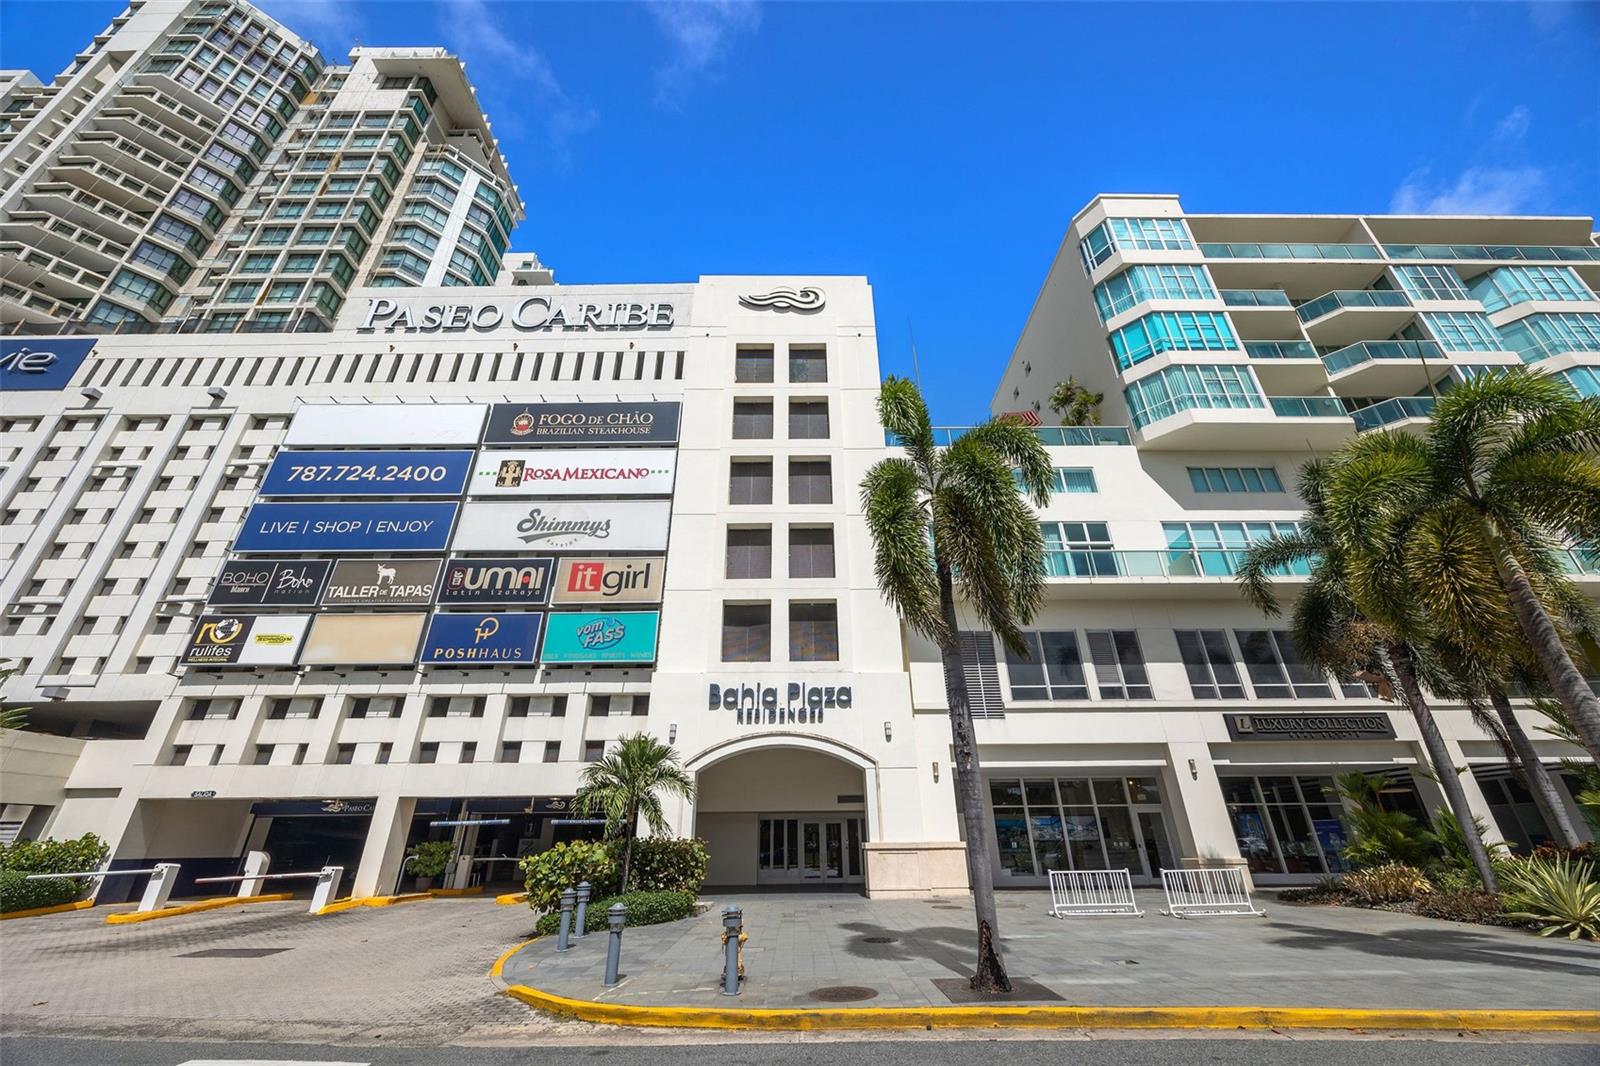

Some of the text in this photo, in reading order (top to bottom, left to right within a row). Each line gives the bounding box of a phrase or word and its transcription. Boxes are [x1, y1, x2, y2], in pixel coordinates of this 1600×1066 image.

[356, 296, 675, 333] PASEO CARIBE
[539, 411, 654, 425] FOGO DE CHÃO
[536, 426, 651, 436] BRAZILIAN STEAKHOUSE
[286, 466, 447, 482] 787.724.2400
[259, 520, 434, 534] LIVE SHOP ENJOY
[516, 508, 612, 539] Shimmys
[220, 572, 270, 584] BOHO
[276, 566, 314, 590] Boho
[328, 585, 379, 598] TALLER
[389, 584, 433, 597] TAPAS
[576, 621, 604, 637] vom
[583, 625, 626, 648] FASS
[189, 645, 233, 657] rulifes
[787, 682, 852, 710] Plaza
[1254, 717, 1386, 731] LUXURY COLLECTION
